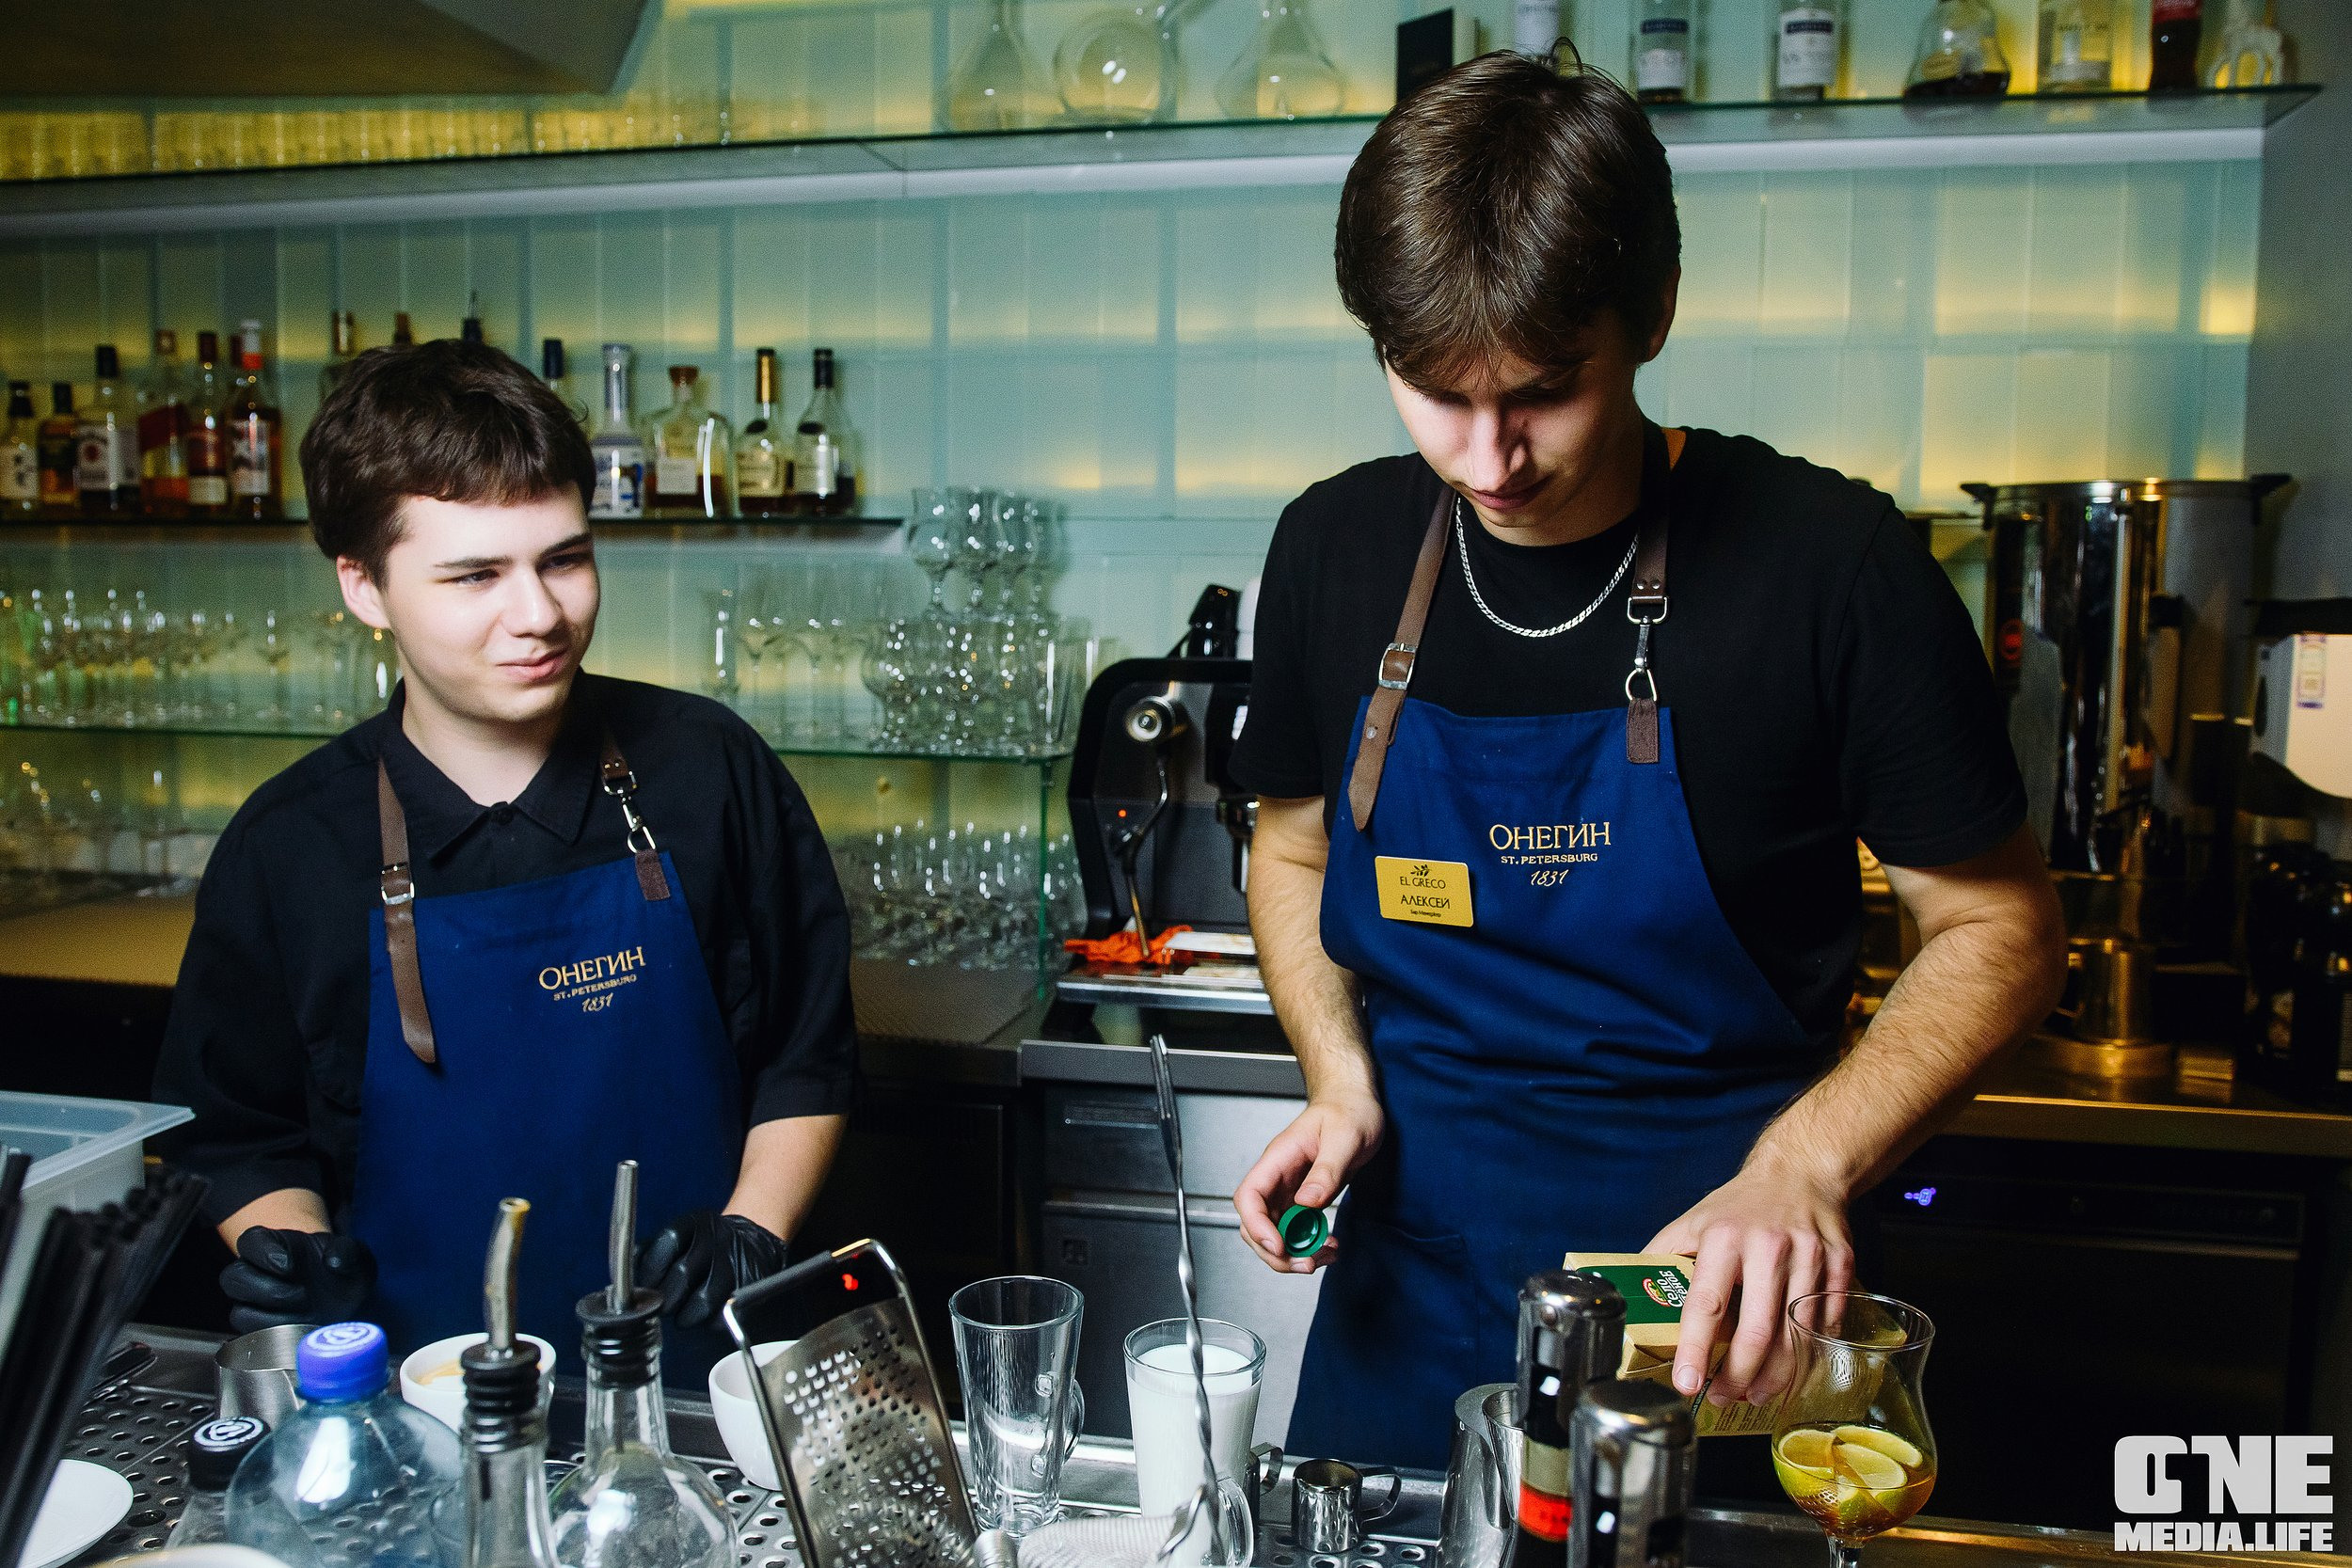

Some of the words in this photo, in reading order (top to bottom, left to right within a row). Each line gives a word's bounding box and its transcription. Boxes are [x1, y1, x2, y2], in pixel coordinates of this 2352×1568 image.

[1489, 822, 1611, 849] ОНЕГИН
[1501, 855, 1518, 864] ST.
[1521, 853, 1597, 864] PETERSBURG
[1400, 877, 1410, 886] EL
[1412, 878, 1446, 889] GRECO
[1531, 869, 1568, 886] 1831
[1401, 895, 1450, 909] АЛЕКСЕЙ
[539, 946, 646, 990] ОНЕГИН
[553, 990, 571, 1001] ST.
[571, 974, 637, 996] PETERSBURG
[1657, 1279, 1683, 1307] Село
